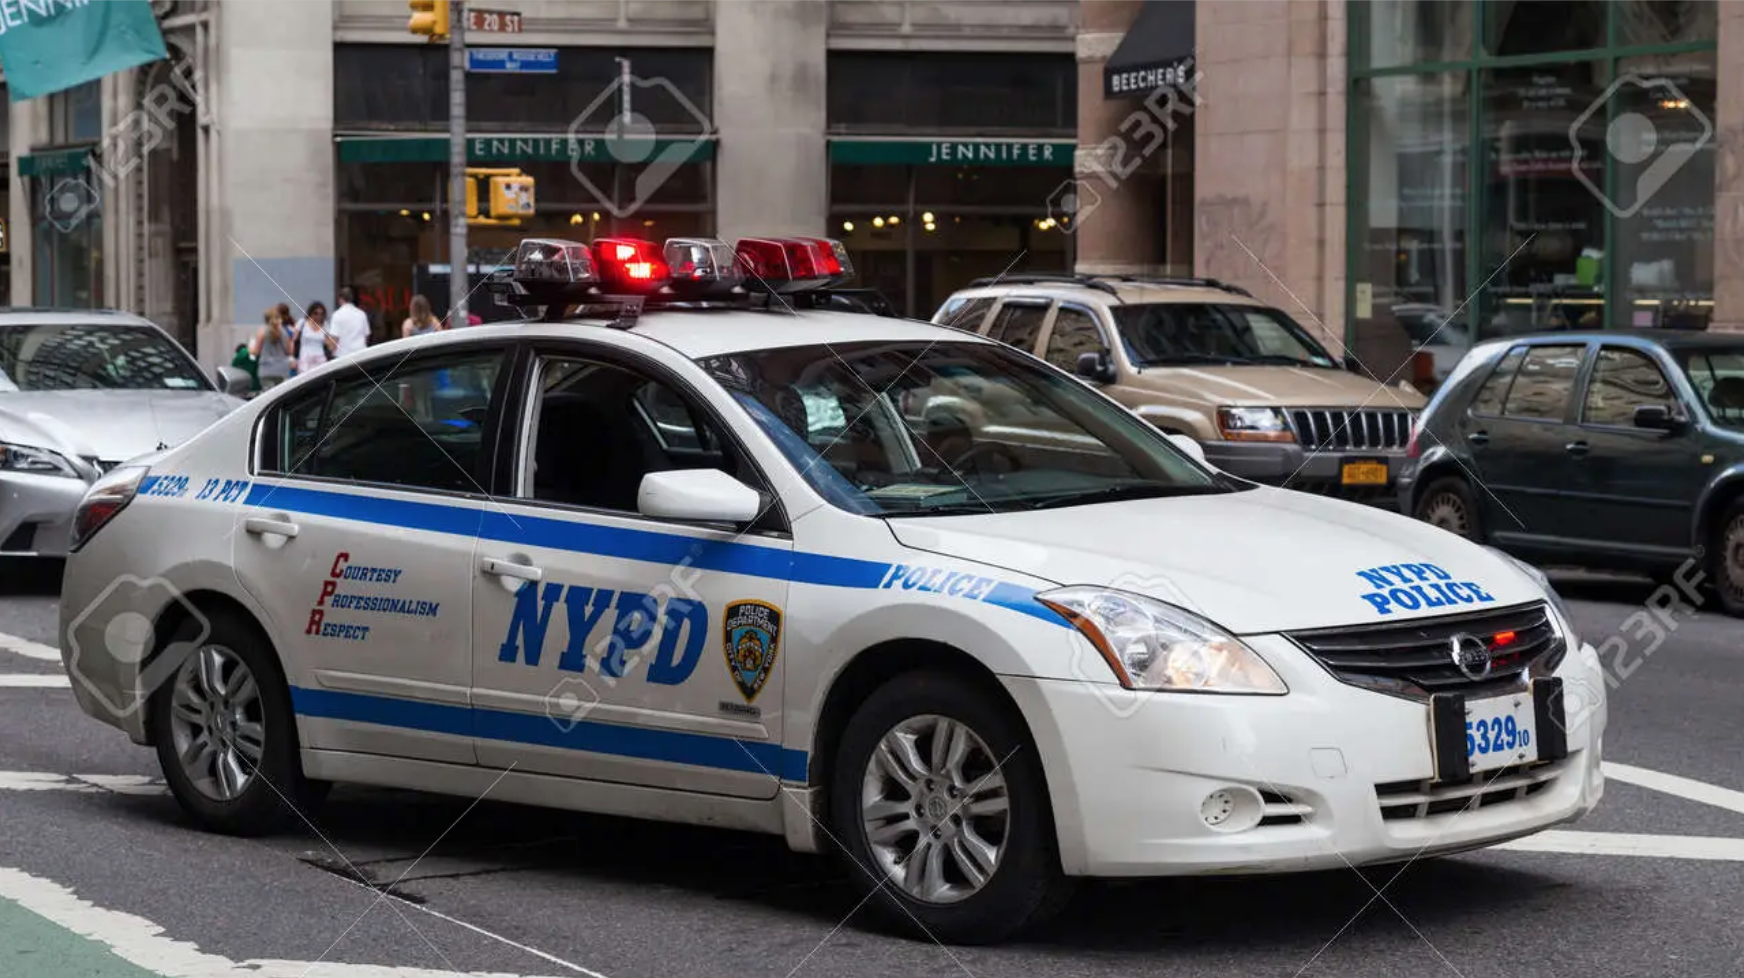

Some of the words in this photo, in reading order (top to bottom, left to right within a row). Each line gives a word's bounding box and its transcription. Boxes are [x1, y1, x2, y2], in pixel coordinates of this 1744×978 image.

[469, 12, 477, 30] E
[483, 13, 499, 31] 20
[505, 15, 519, 33] ST
[1111, 62, 1186, 92] BEECHER'S
[474, 139, 596, 156] ENNIFER
[929, 142, 1053, 162] JENNIFER
[195, 478, 220, 500] 13
[213, 479, 250, 503] PCT
[330, 552, 402, 583] COURTESY
[882, 564, 997, 601] POLICE
[1355, 563, 1452, 590] NYPD
[317, 580, 440, 617] PROFESSIONALISM
[738, 605, 770, 619] POLICE
[1360, 582, 1496, 615] POLICE
[305, 608, 370, 640] RESPECT
[498, 581, 709, 686] NYPD
[726, 615, 778, 637] DEPARTMENT
[1466, 714, 1517, 757] 5329
